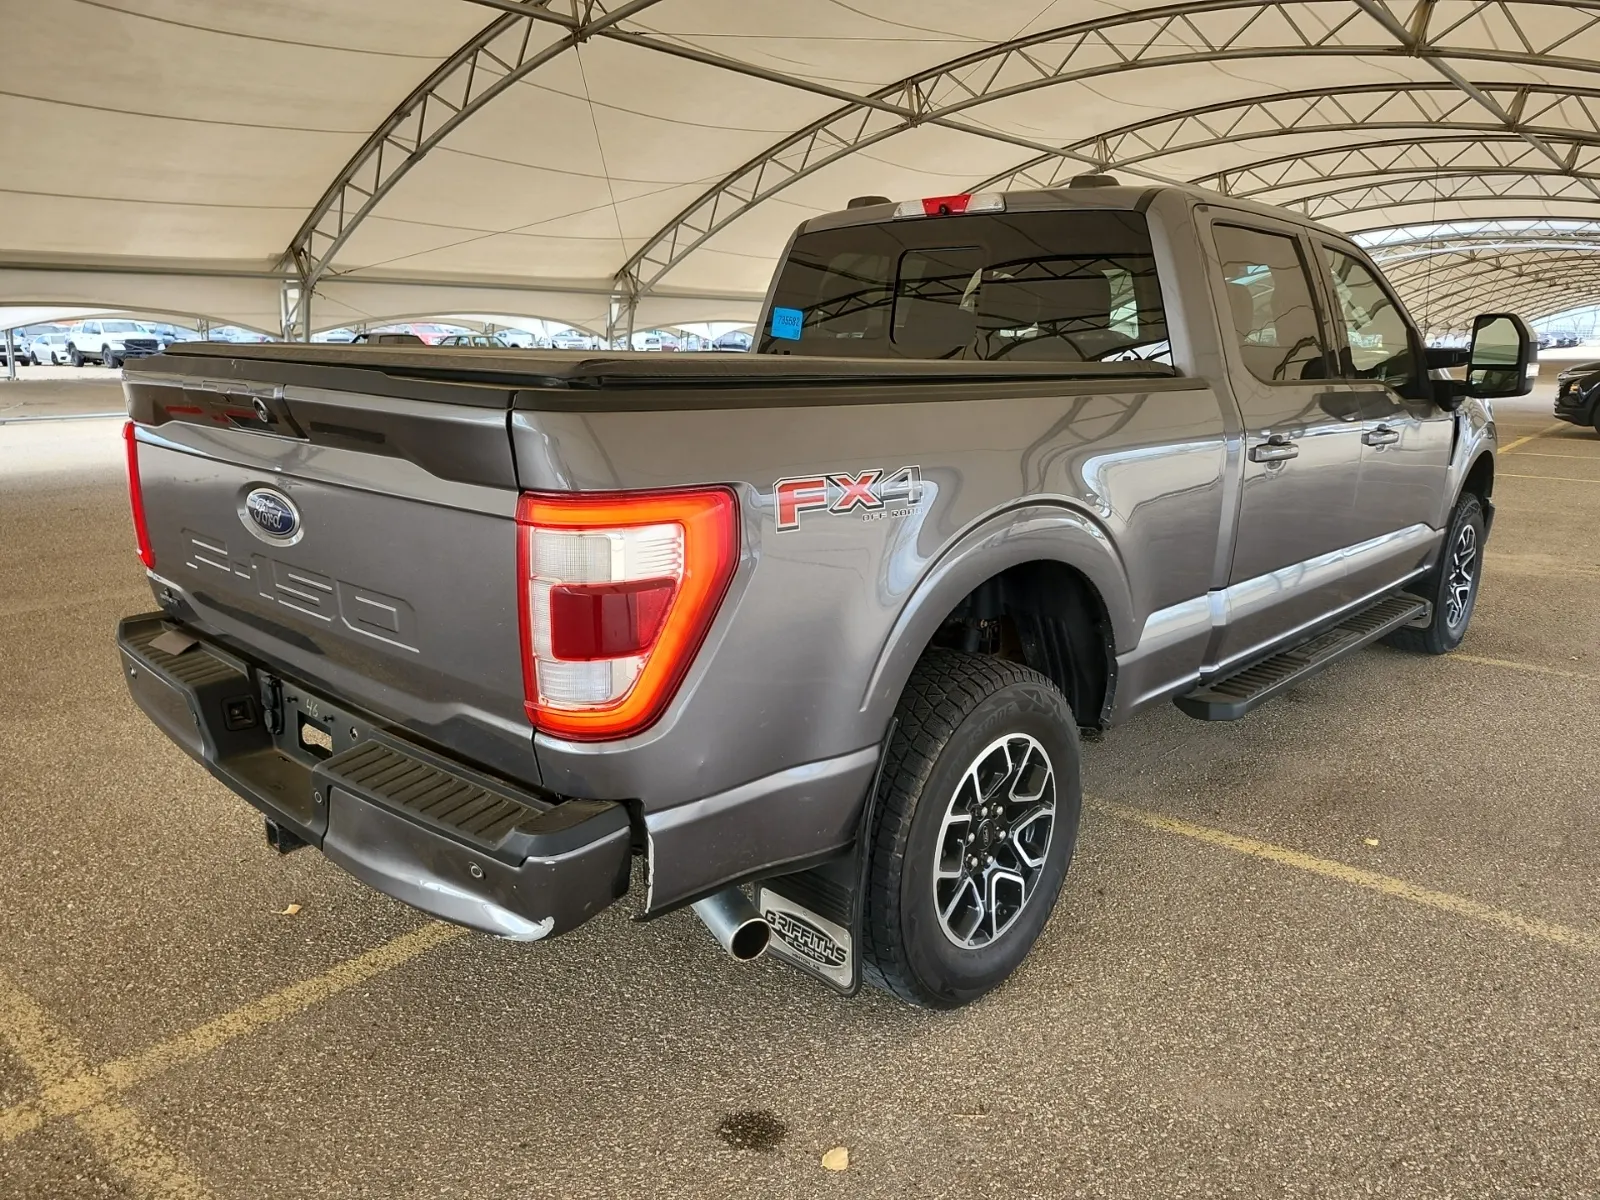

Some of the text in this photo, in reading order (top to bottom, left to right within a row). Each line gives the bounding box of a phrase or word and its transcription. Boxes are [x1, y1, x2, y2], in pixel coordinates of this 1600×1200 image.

[254, 498, 283, 528] Ford
[773, 465, 924, 534] FX4
[861, 512, 887, 522] OFF
[181, 527, 420, 653] F-150
[306, 698, 319, 717] 46
[764, 908, 849, 963] GRIFFITHS
[785, 935, 826, 962] FORD
